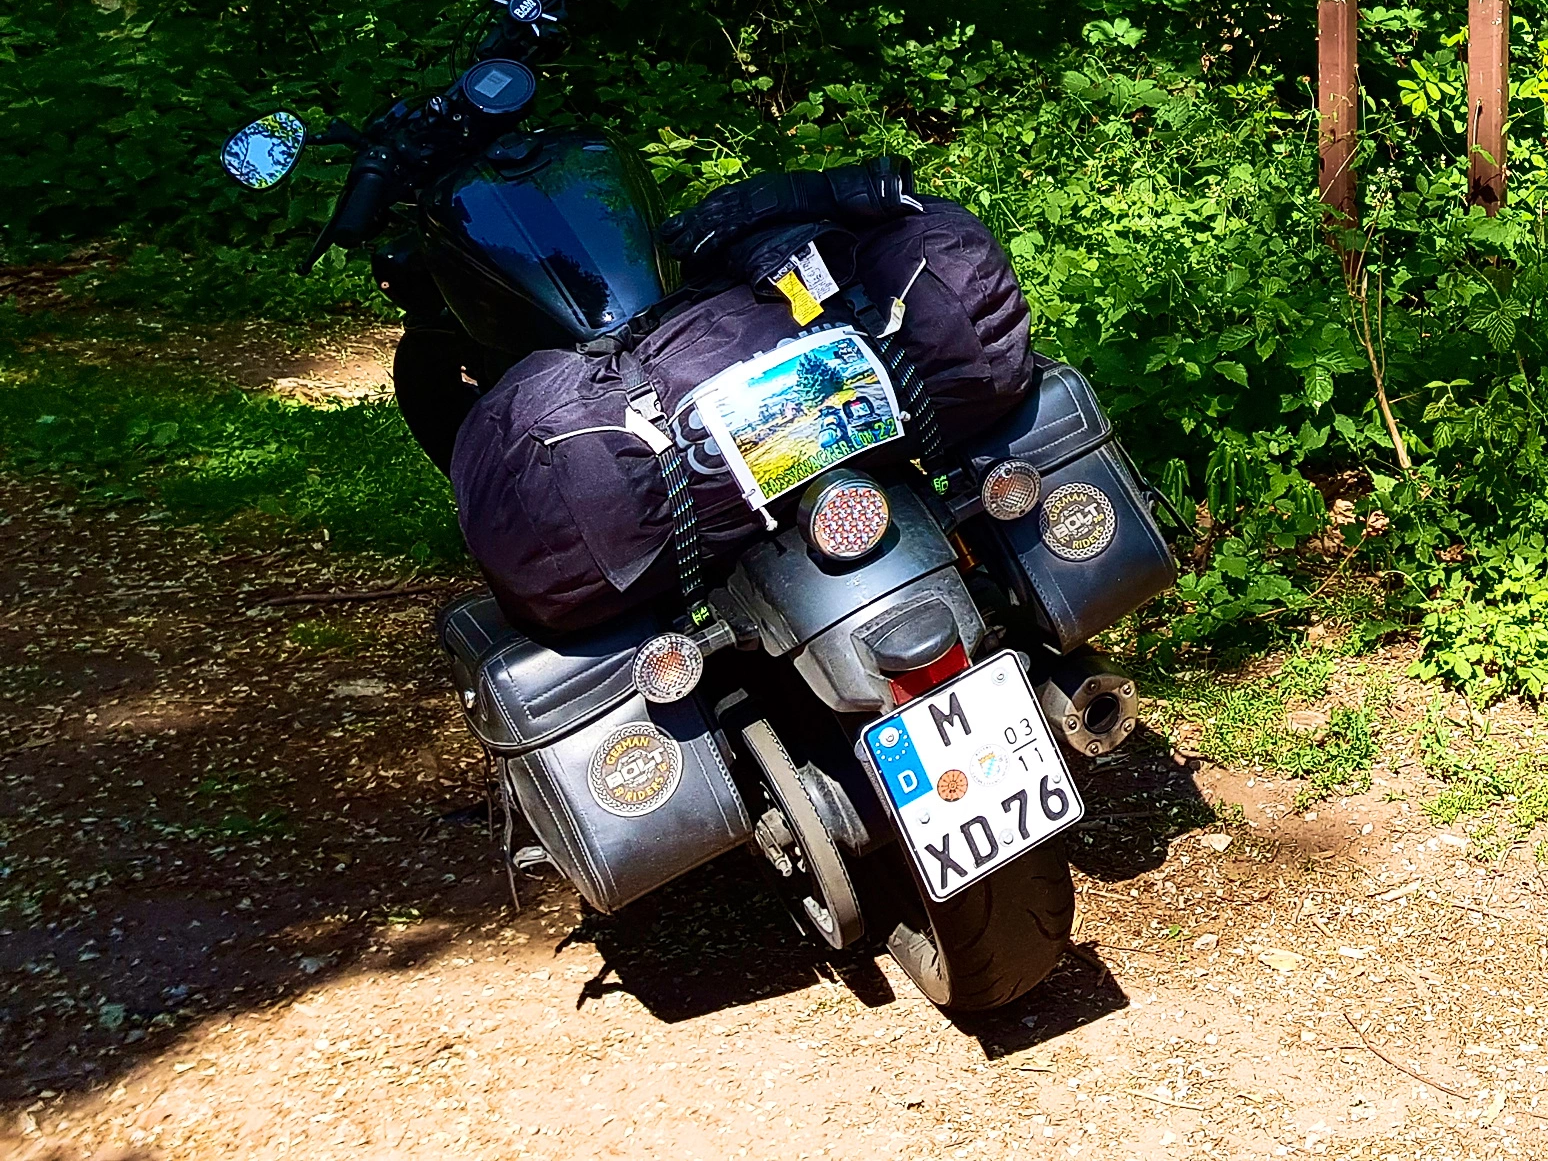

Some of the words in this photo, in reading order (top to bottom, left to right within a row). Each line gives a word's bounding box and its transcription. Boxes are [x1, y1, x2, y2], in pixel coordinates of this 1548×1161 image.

[873, 418, 897, 440] 22
[1049, 492, 1088, 521] GERMAN
[1052, 502, 1098, 539] BOLT
[1072, 525, 1104, 549] RIDERS
[928, 692, 972, 747] M
[1004, 718, 1033, 745] 03
[606, 738, 649, 765] GERMAN
[1018, 747, 1043, 771] 11
[604, 747, 665, 789] BOLT
[897, 769, 918, 794] D
[624, 776, 664, 801] RIDERS
